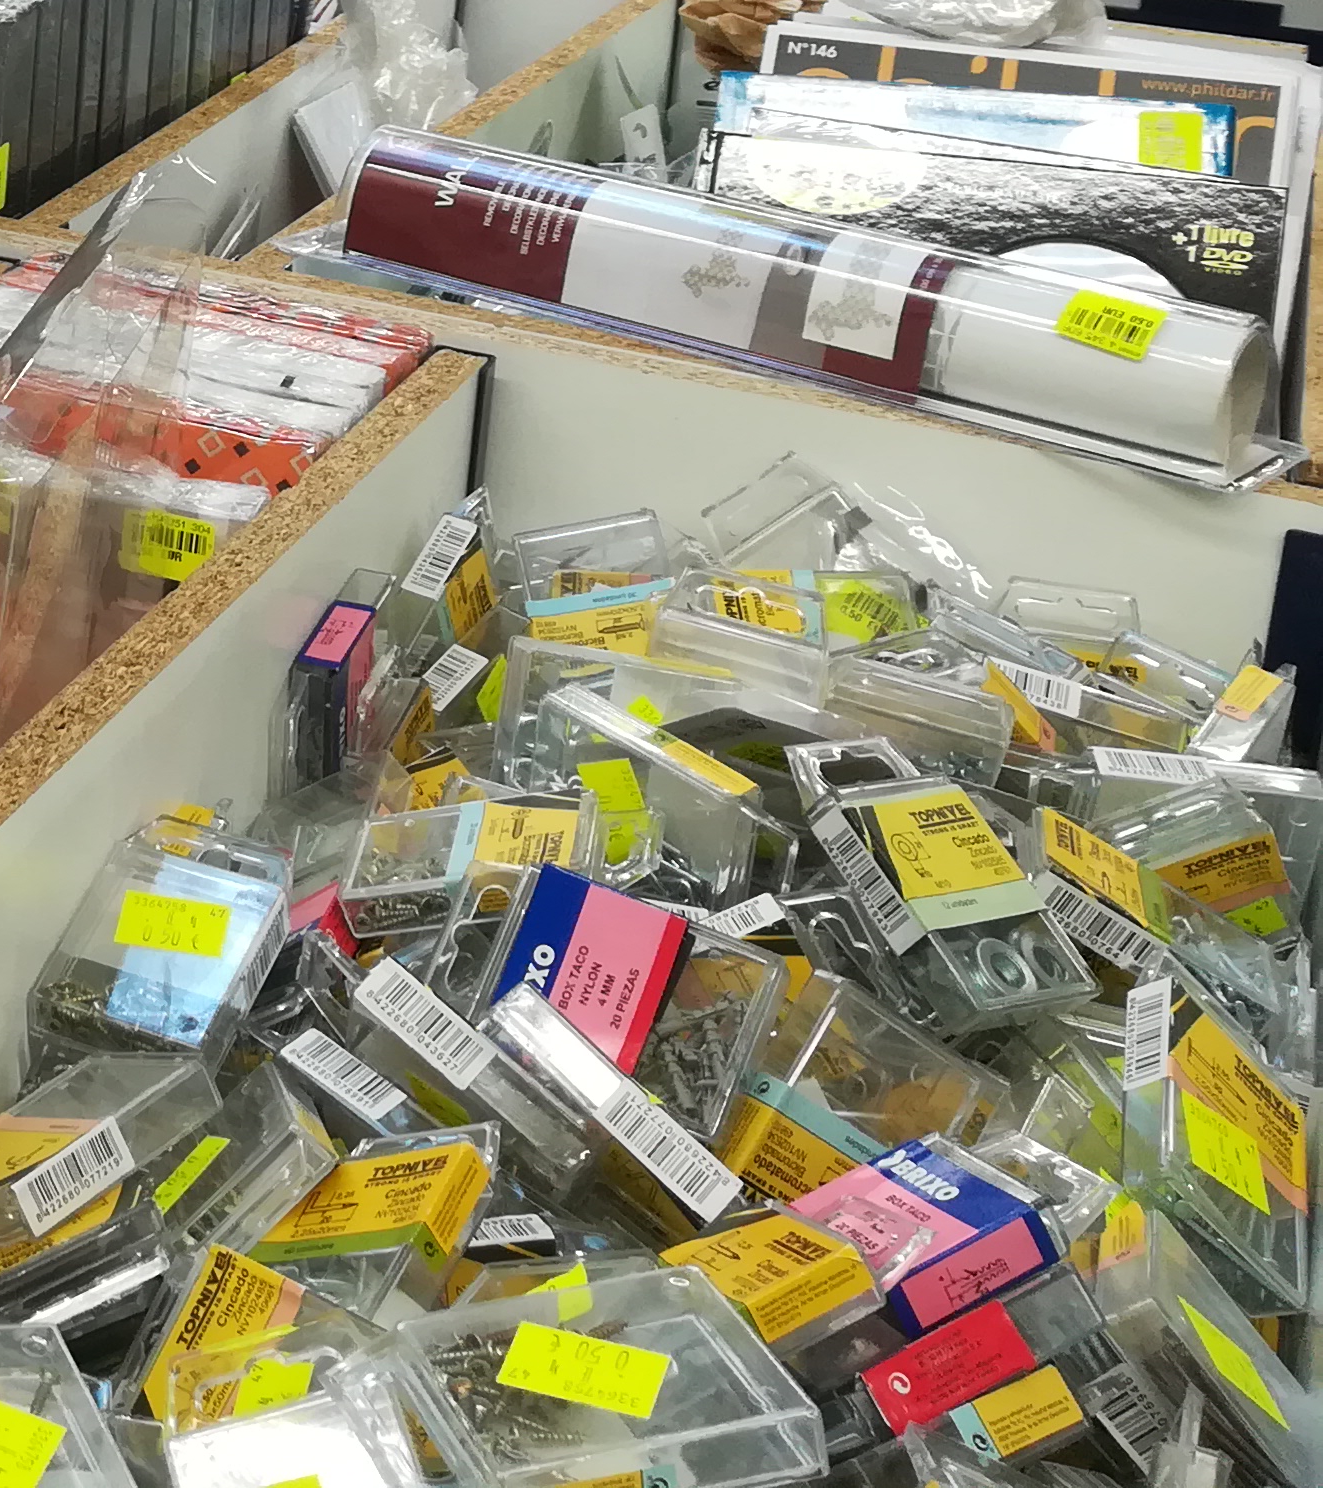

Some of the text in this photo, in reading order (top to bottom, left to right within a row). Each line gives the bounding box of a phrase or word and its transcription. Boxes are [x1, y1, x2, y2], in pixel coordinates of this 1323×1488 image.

[787, 40, 839, 59] N°146
[1141, 77, 1275, 103] www.phildar.fr
[1202, 248, 1253, 262] DVD
[1102, 306, 1125, 318] EUR
[558, 945, 589, 1010] BOX TACO
[578, 962, 603, 1006] NYLON
[597, 975, 616, 1007] 4 MM
[610, 968, 640, 1030] 20 PIEZAS
[891, 1157, 960, 1203] BRIXO
[884, 1193, 931, 1222] BOX TACO
[176, 1249, 231, 1347] TOPNIVEL
[216, 1267, 250, 1328] Cincado
[233, 1275, 259, 1323] Zincado
